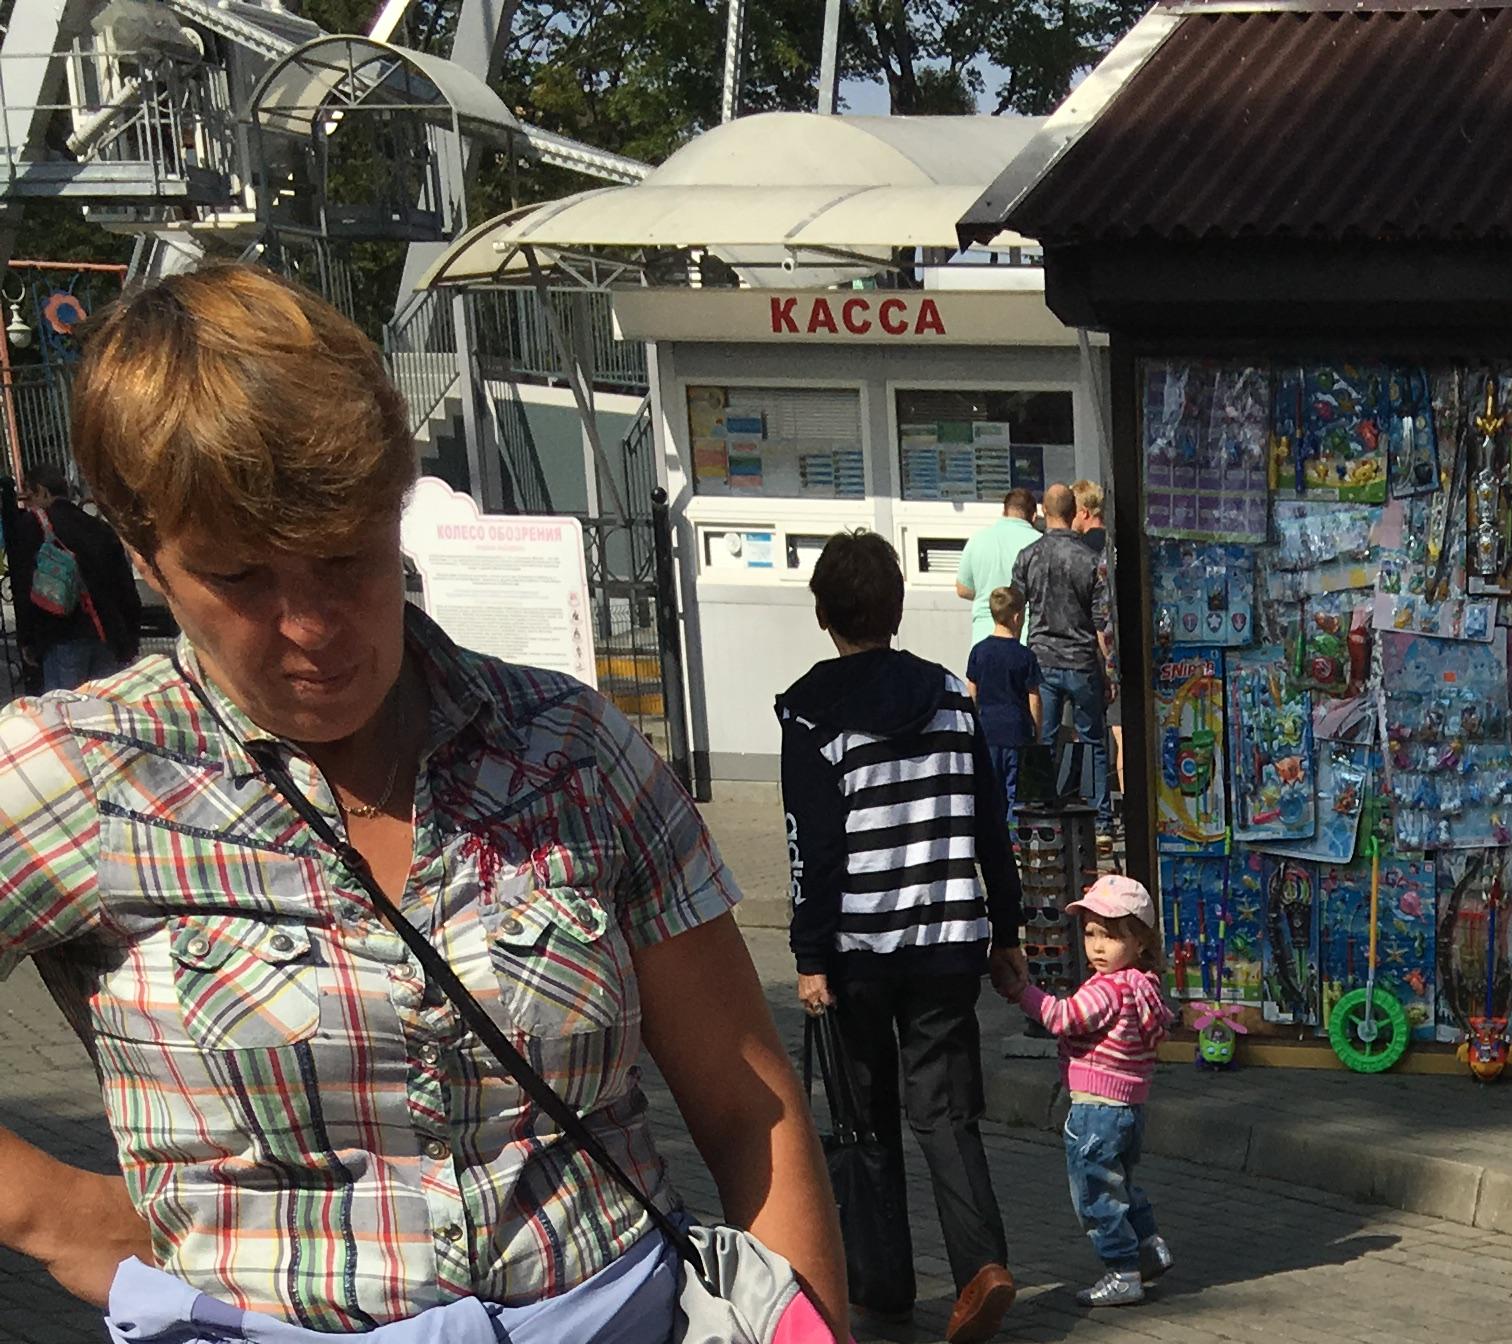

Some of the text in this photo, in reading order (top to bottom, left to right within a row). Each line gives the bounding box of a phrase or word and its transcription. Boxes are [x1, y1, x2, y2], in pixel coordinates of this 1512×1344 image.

[770, 296, 946, 335] КАССА
[437, 524, 562, 542] КОЛЕСО ОБОЗРЕНИЯ
